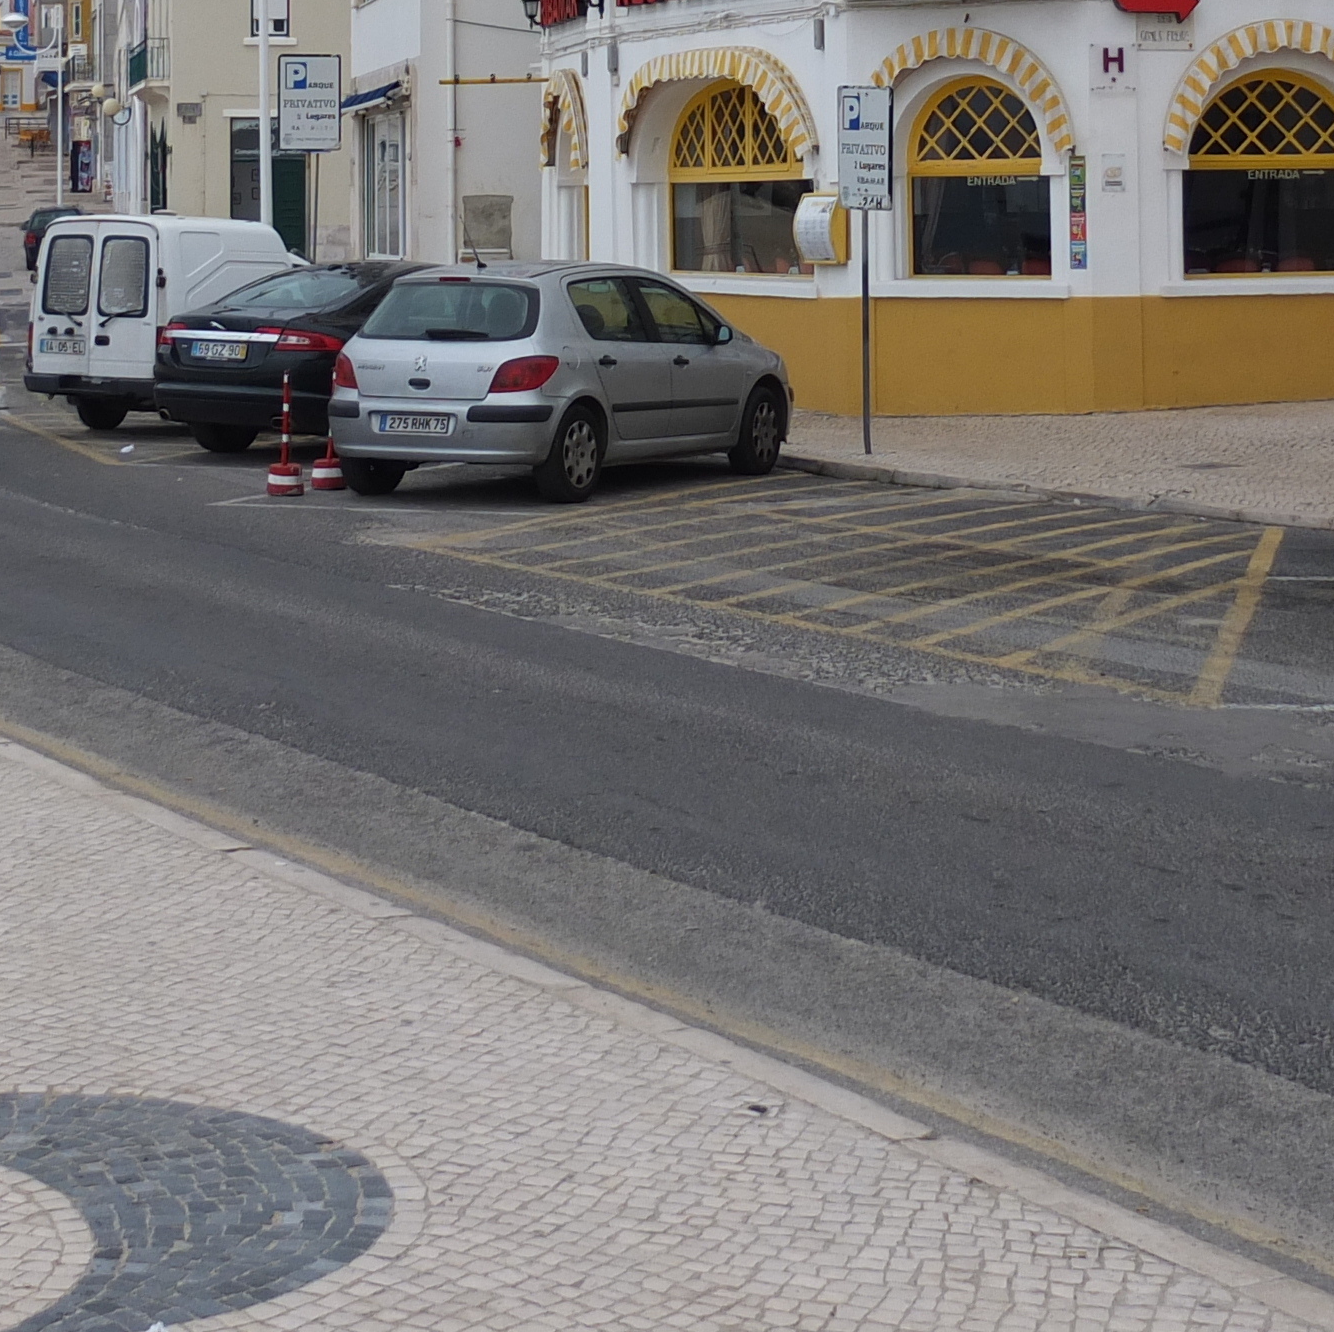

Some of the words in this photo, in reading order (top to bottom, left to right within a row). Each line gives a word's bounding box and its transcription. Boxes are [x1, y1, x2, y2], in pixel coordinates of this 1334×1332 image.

[1103, 47, 1125, 73] H
[283, 99, 337, 108] PRIVATIVO
[841, 143, 886, 156] PRIVATIVO
[859, 161, 886, 172] Lugares
[1247, 169, 1300, 179] ENTRADA
[967, 176, 1016, 186] ENTRADA
